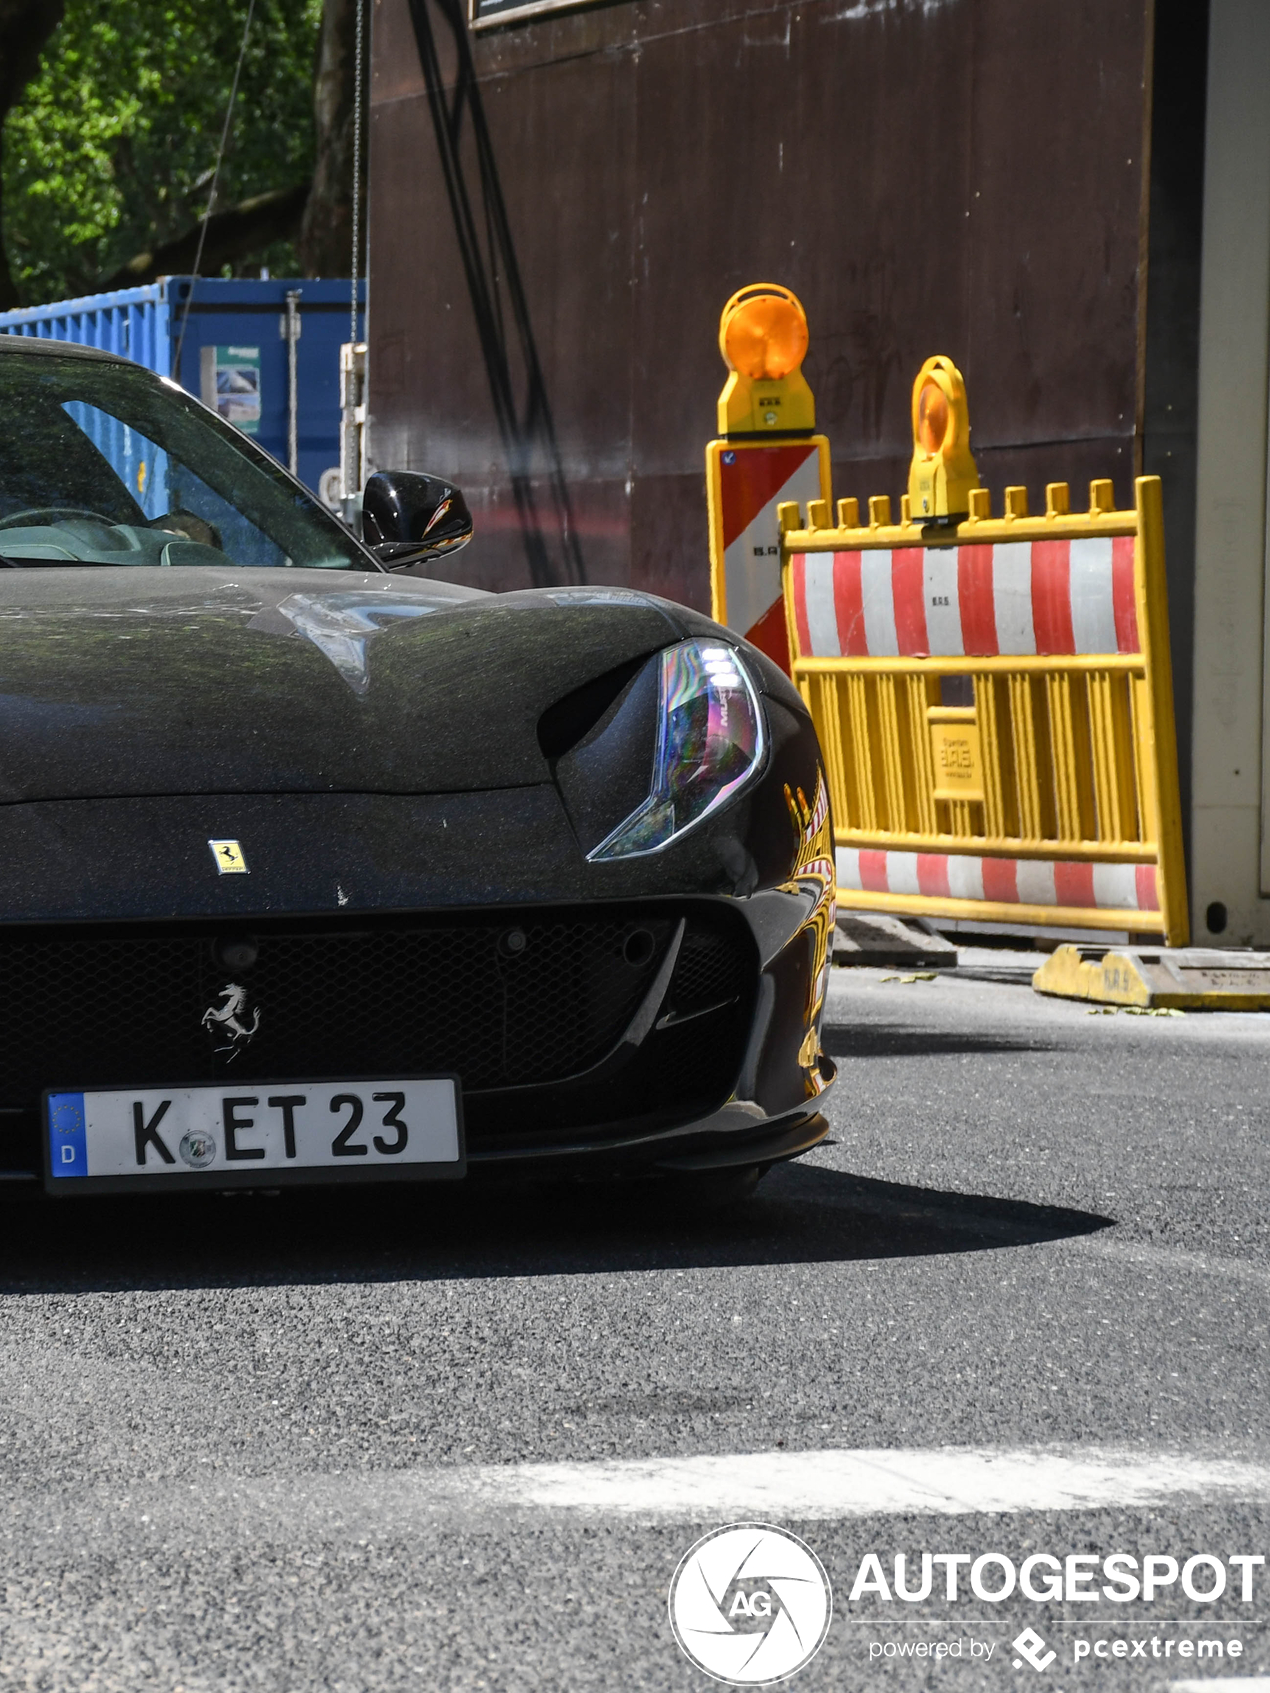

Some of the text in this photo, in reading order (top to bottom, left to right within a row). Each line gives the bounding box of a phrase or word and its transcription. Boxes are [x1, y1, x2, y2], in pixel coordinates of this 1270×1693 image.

[132, 1091, 409, 1165] K ET 23
[61, 1145, 75, 1164] D
